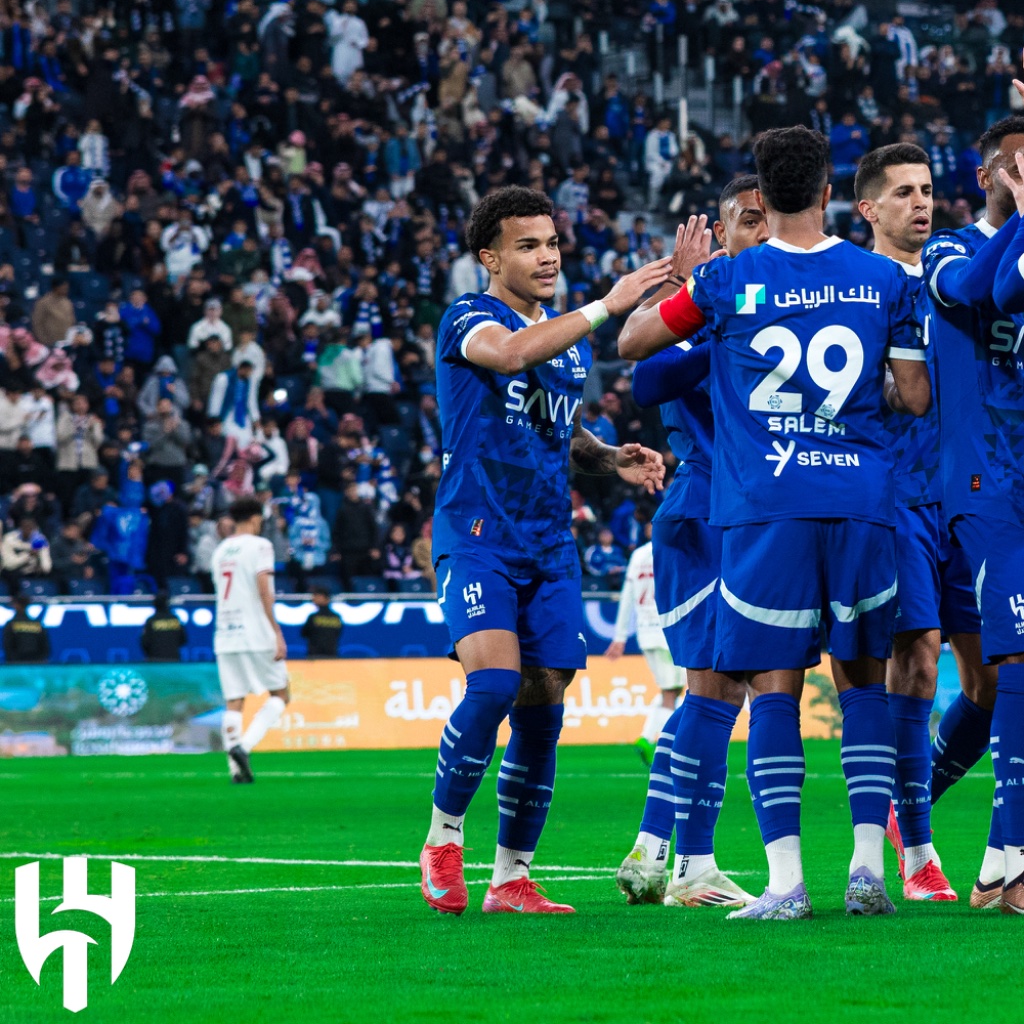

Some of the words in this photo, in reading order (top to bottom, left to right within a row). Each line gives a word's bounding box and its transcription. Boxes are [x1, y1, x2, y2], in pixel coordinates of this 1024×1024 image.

[773, 285, 835, 309] الرياض
[838, 285, 880, 309] بنك
[749, 325, 863, 420] 29
[505, 379, 583, 427] SAVV
[767, 414, 846, 437] SALEM
[797, 451, 860, 467] SEVEN
[222, 571, 233, 600] 7
[1006, 778, 1019, 786] AL
[697, 799, 712, 808] AL
[901, 798, 914, 806] AL
[916, 795, 932, 805] HILA
